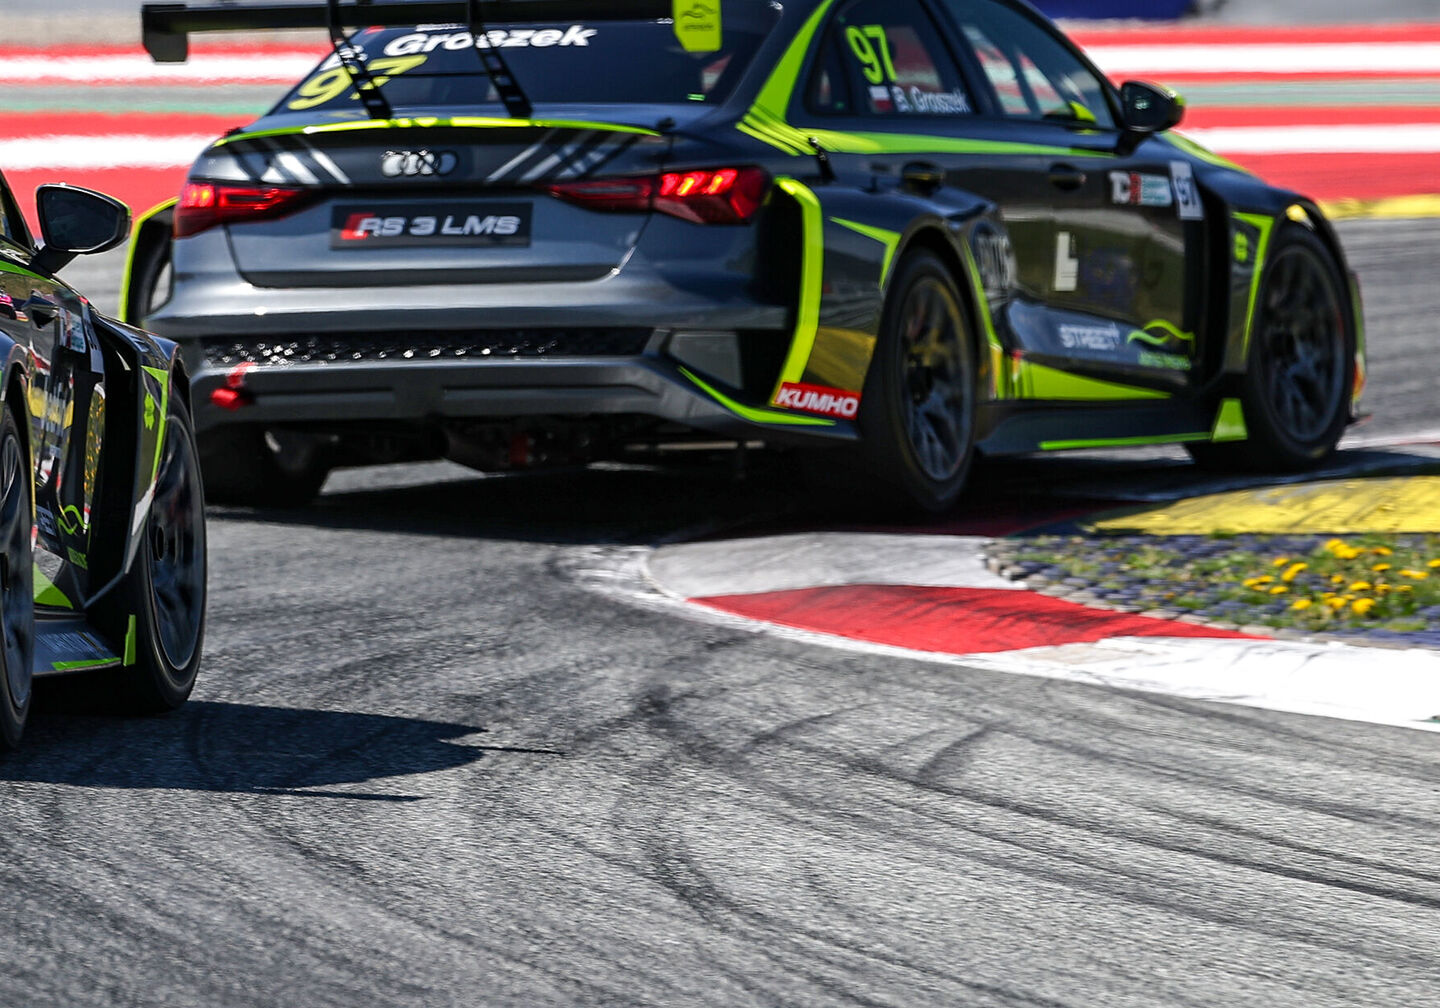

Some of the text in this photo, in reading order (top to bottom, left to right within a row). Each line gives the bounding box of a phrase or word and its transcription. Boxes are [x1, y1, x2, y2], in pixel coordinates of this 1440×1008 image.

[845, 24, 897, 84] 97
[356, 215, 521, 237] RS 3 LMS
[775, 387, 859, 416] KUMHO
